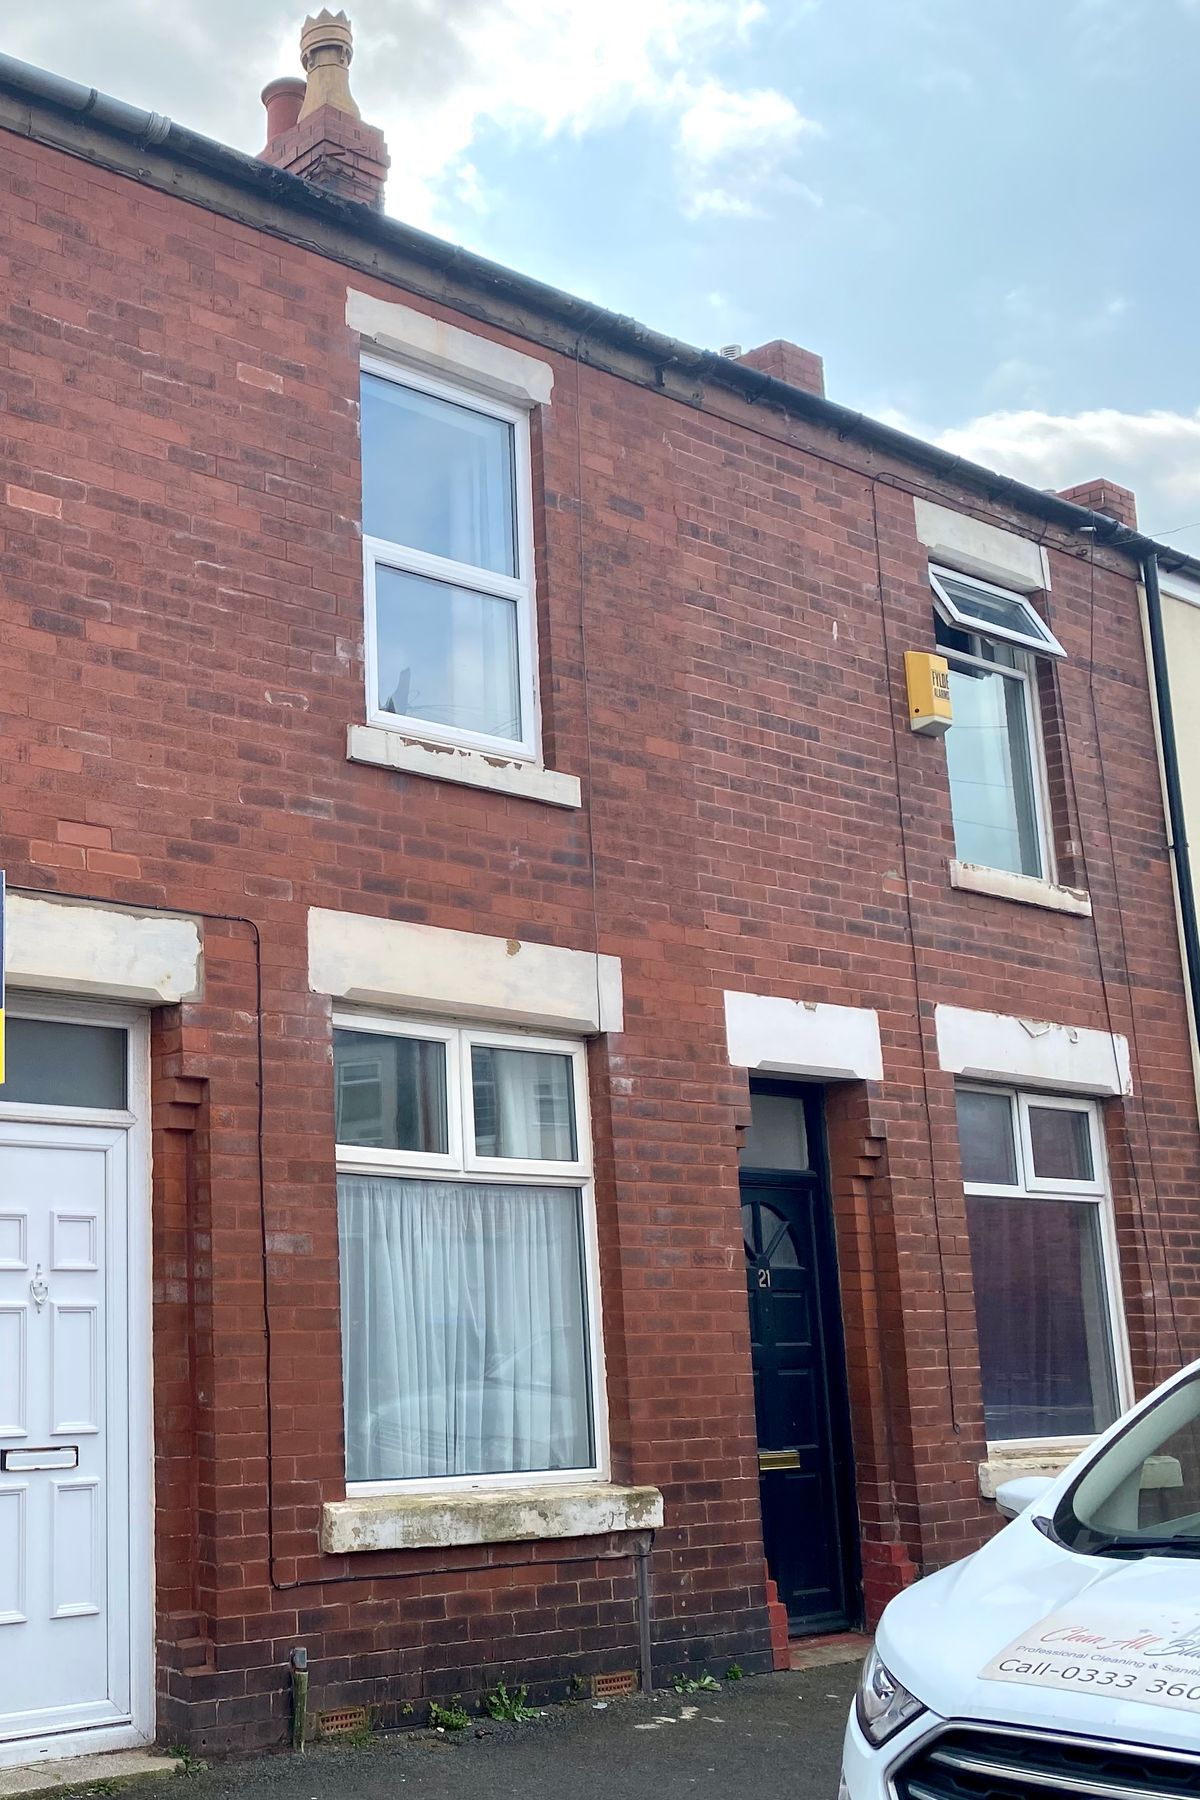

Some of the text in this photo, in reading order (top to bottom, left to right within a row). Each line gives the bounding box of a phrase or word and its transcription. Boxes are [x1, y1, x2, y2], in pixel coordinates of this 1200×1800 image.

[758, 1269, 771, 1288] 21
[1016, 1645, 1088, 1660] Professional
[1090, 1654, 1146, 1669] Cleaning
[1148, 1662, 1158, 1670] &
[999, 1658, 1200, 1700] Call-0333 360
